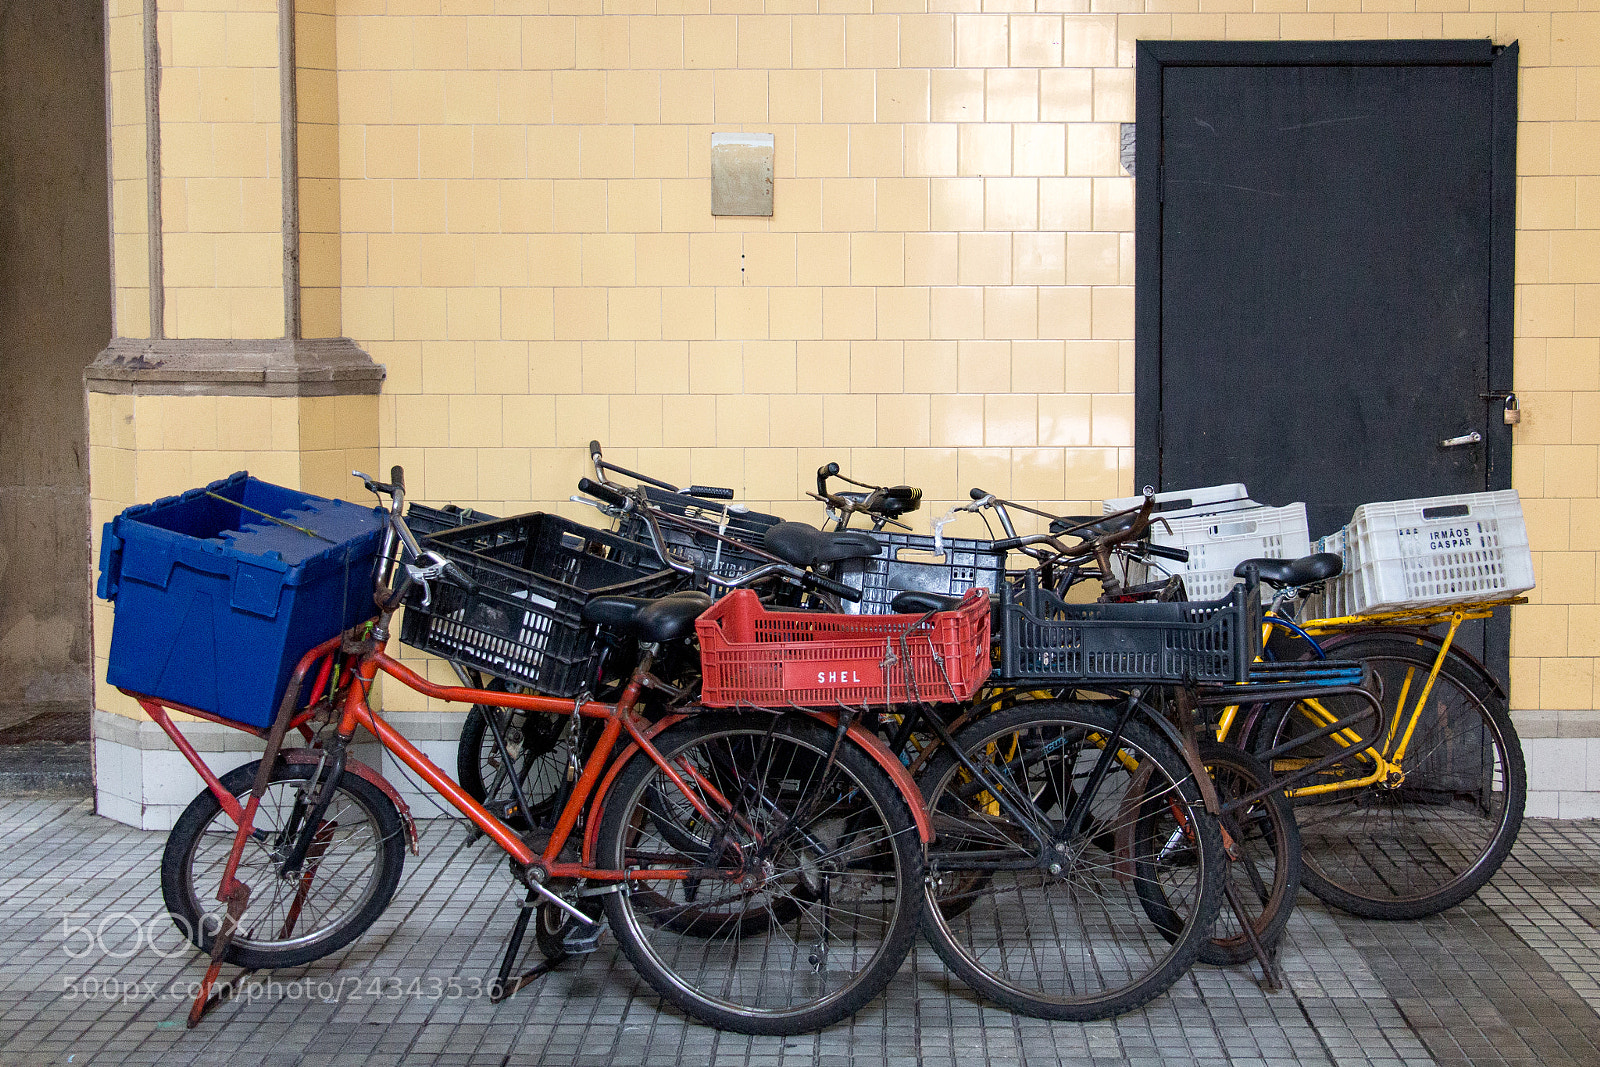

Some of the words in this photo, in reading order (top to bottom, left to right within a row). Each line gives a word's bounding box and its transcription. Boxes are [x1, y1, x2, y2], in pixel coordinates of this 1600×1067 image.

[1429, 527, 1470, 541] IRMÃOS
[1430, 537, 1472, 550] GASPAR
[817, 670, 861, 684] SHEL
